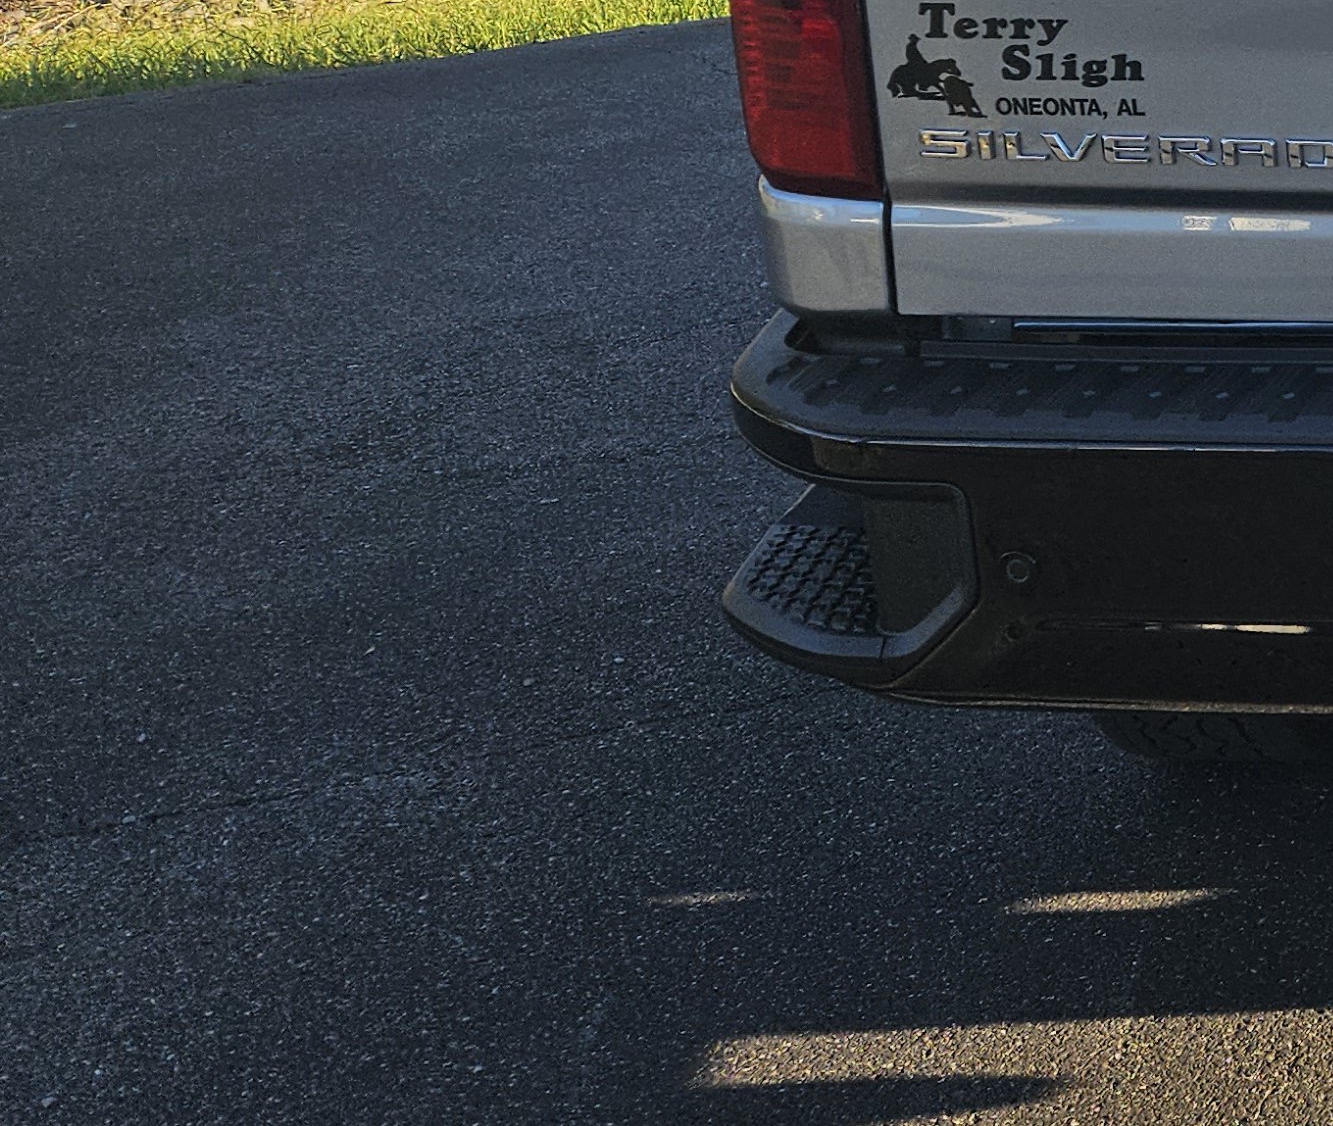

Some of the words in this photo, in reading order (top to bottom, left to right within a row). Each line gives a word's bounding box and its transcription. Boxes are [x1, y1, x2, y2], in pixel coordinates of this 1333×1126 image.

[918, 2, 1069, 46] Terry
[1000, 44, 1145, 88] Sligh
[995, 97, 1108, 119] ONEONTA,
[1116, 97, 1146, 117] AL
